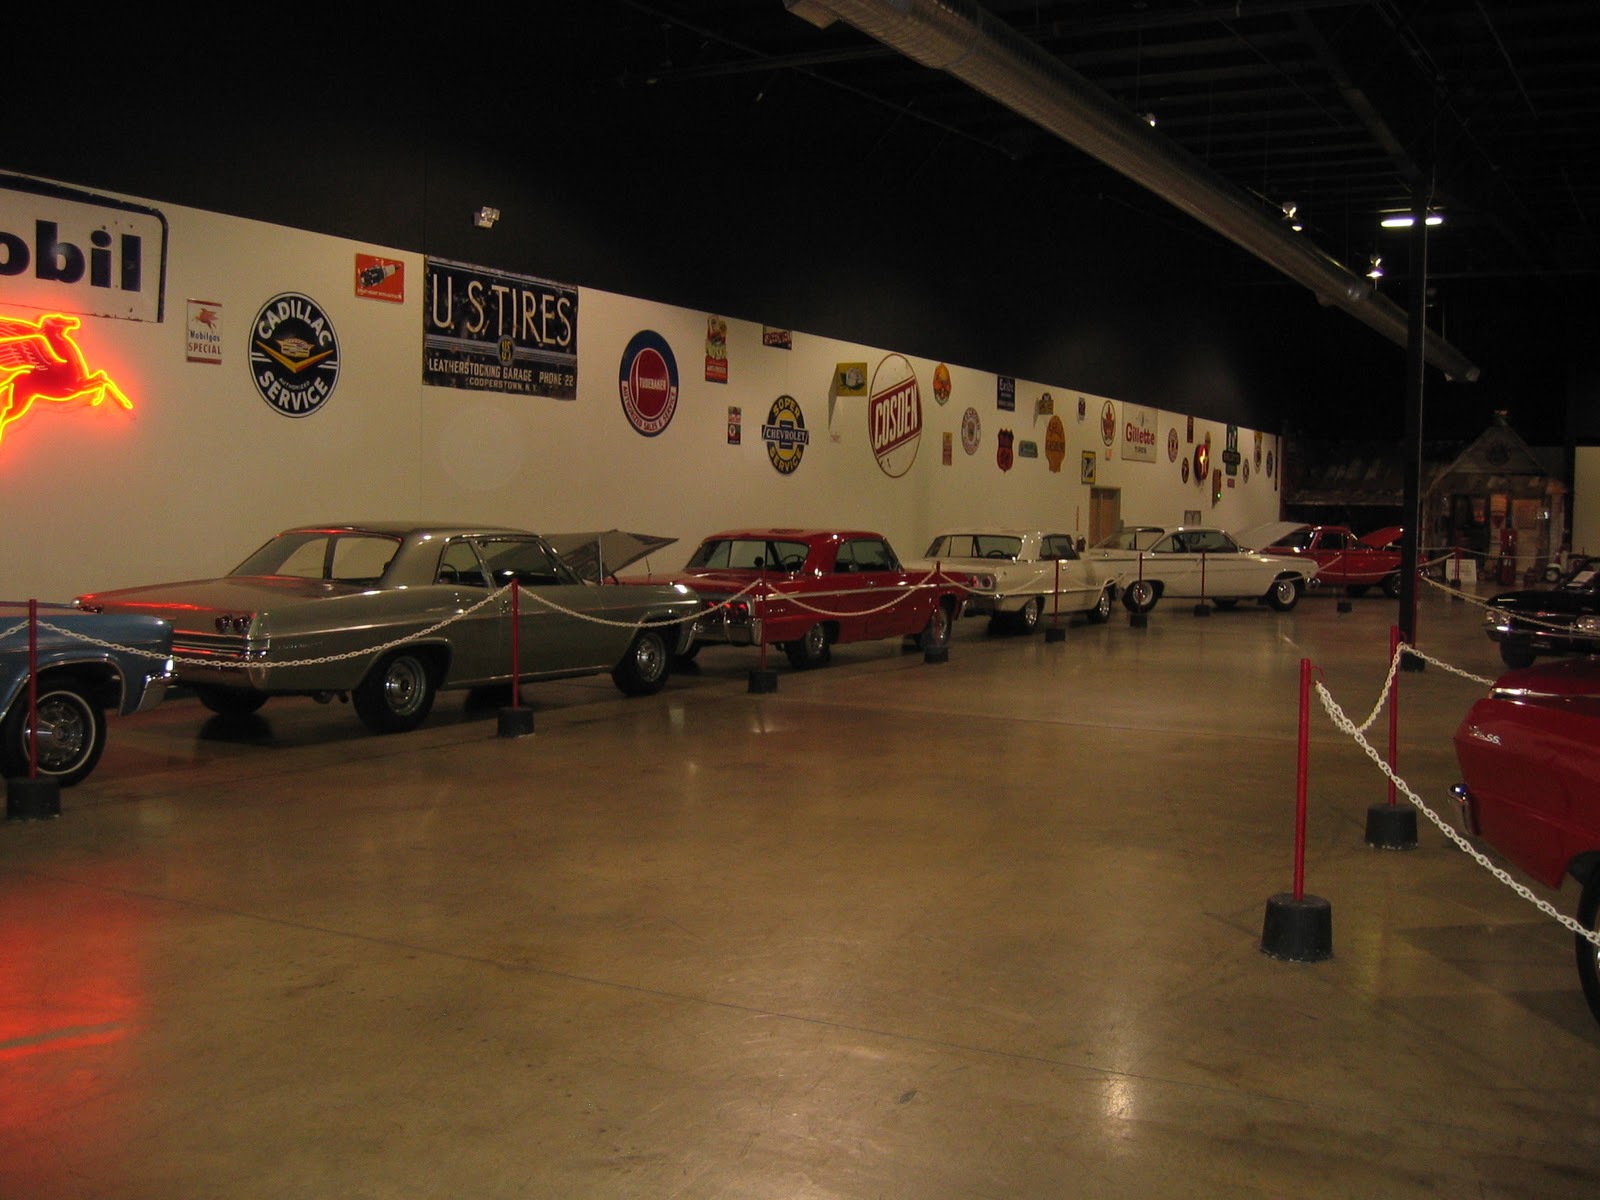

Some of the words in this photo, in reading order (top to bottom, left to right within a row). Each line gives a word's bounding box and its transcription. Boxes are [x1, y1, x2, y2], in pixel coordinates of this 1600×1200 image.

[258, 300, 333, 347] CADILLAC
[491, 284, 571, 347] TIRES
[188, 343, 222, 355] SPECIAL
[189, 330, 221, 343] Mobilgas
[429, 358, 501, 379] LEATHERSTOCKING
[503, 366, 532, 382] GARAGE
[539, 371, 562, 387] PHONE
[564, 375, 574, 387] 22
[259, 371, 329, 411] SERVICE
[773, 397, 800, 418] SUPER
[874, 383, 918, 450] COSDEN
[765, 427, 806, 442] CHEVROLET
[1125, 422, 1155, 446] Gillette
